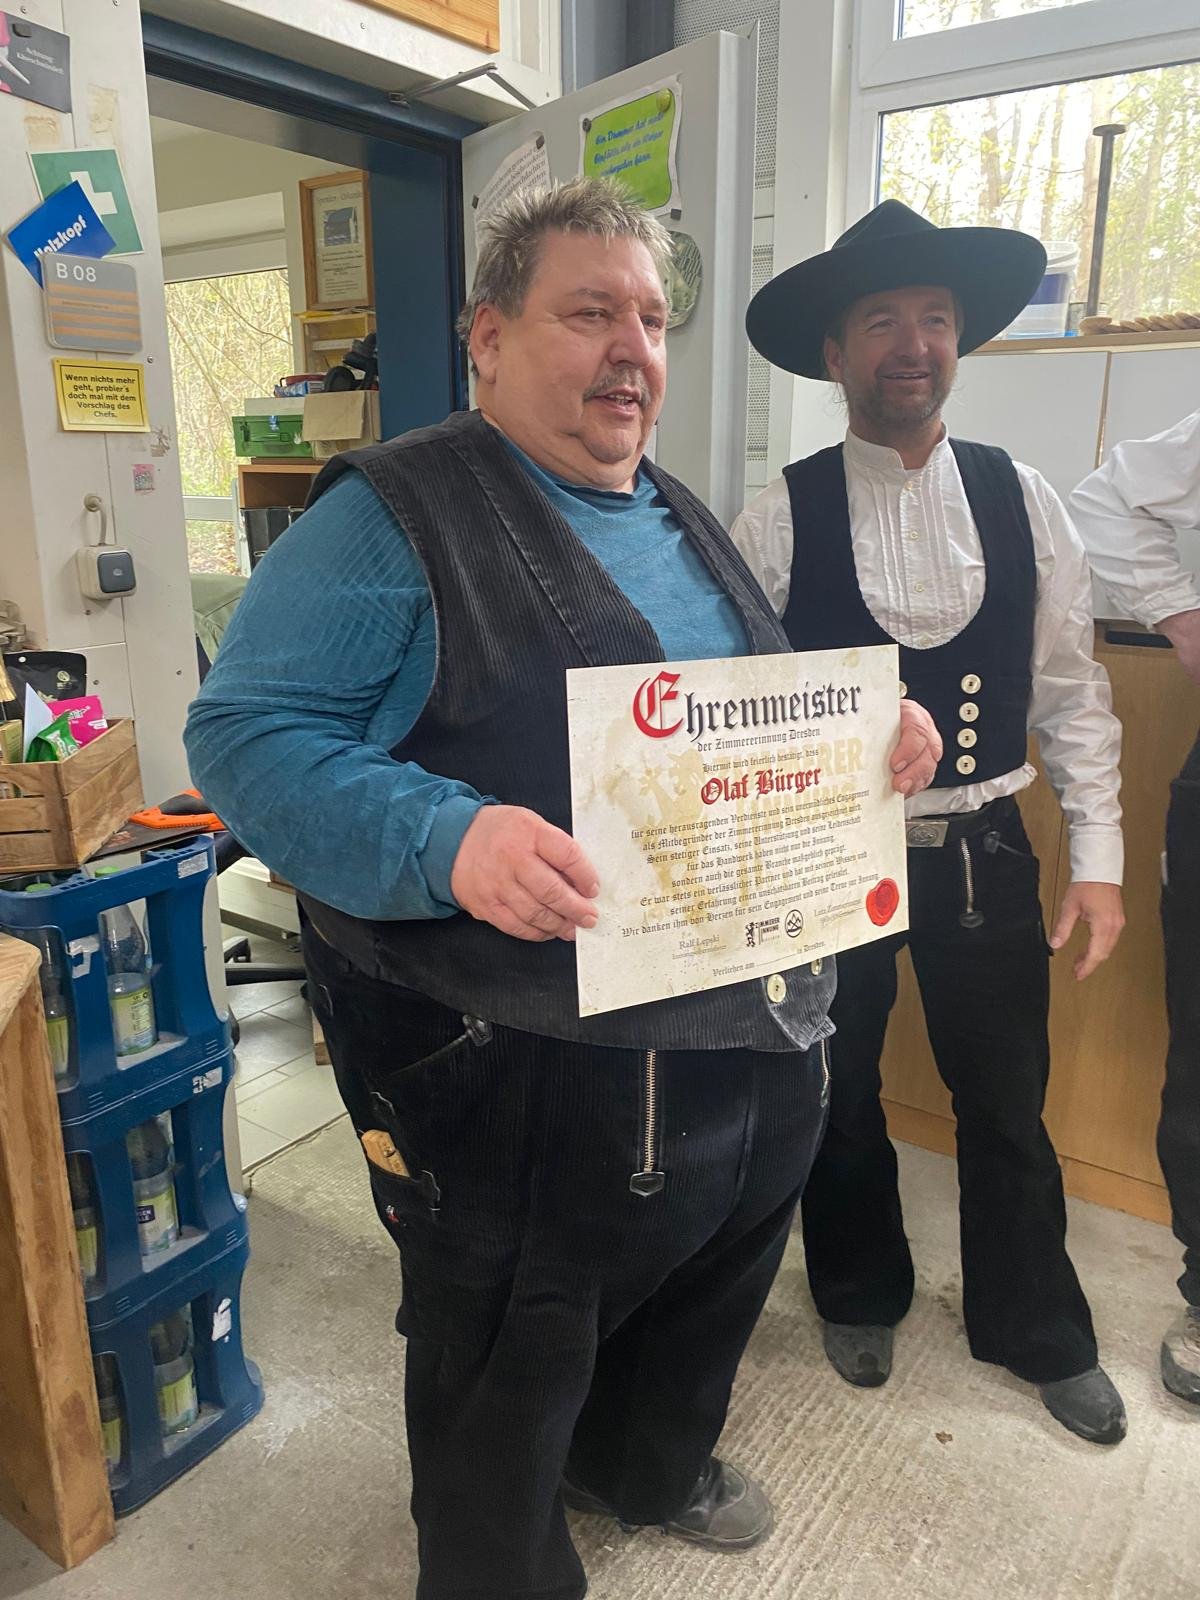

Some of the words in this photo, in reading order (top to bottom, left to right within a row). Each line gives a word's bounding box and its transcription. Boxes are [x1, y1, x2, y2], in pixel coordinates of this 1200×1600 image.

[56, 262, 68, 278] B
[73, 265, 97, 282] 08
[73, 384, 93, 392] geht,
[90, 375, 114, 383] nichts
[68, 392, 87, 400] doch
[105, 393, 119, 401] mit
[76, 401, 115, 410] Vorschlag
[93, 410, 118, 418] Chefs.
[633, 671, 861, 742] Ehrenmeister
[697, 741, 712, 752] der
[715, 733, 787, 750] Zimmererinnung
[788, 728, 821, 741] Dresden
[702, 761, 731, 773] Hiermit
[733, 758, 749, 768] wird
[750, 754, 776, 767] feierlich
[805, 748, 819, 757] dass
[701, 773, 749, 805] Olaf
[755, 767, 821, 800] Bürger
[646, 827, 667, 836] seine
[669, 818, 729, 834] herausragenden
[731, 810, 767, 823] Verdienste
[768, 807, 780, 816] und
[781, 805, 794, 814] sein
[836, 789, 870, 803] Engagement
[642, 843, 656, 851] als
[658, 833, 713, 850] Mitbegründer
[714, 830, 726, 840] der
[728, 820, 784, 837] Zimmererinnung
[785, 814, 811, 827] Dresden
[647, 854, 668, 864] Sein
[670, 849, 700, 861] stetiger
[702, 843, 733, 855] Einsatz,
[734, 839, 752, 850] seine
[799, 827, 811, 836] und
[812, 824, 827, 833] seine
[701, 859, 714, 868] das
[716, 851, 753, 866] Handwerk
[754, 848, 774, 860] haben
[774, 844, 789, 854] nicht
[802, 840, 811, 848] die
[640, 897, 652, 907] Er
[654, 895, 670, 904] war
[672, 890, 692, 901] stets
[693, 888, 706, 898] ein
[755, 873, 781, 886] Partner
[782, 869, 794, 879] und
[857, 851, 868, 860] und
[671, 876, 703, 888] sondern
[705, 872, 722, 882] auch
[723, 869, 734, 879] die
[736, 864, 763, 877] gesamte
[765, 859, 791, 870] Branche
[670, 905, 695, 916] seiner
[697, 896, 737, 911] Erfahrung
[738, 891, 757, 903] einen
[802, 875, 824, 887] Beitrag
[622, 927, 640, 938] Wir
[641, 922, 671, 934] danken
[673, 918, 688, 929] ihm
[690, 916, 704, 925] von
[706, 910, 734, 922] Herzen
[748, 904, 762, 914] sein
[763, 894, 802, 910] Engagement
[803, 890, 814, 899] und
[814, 887, 829, 896] seine
